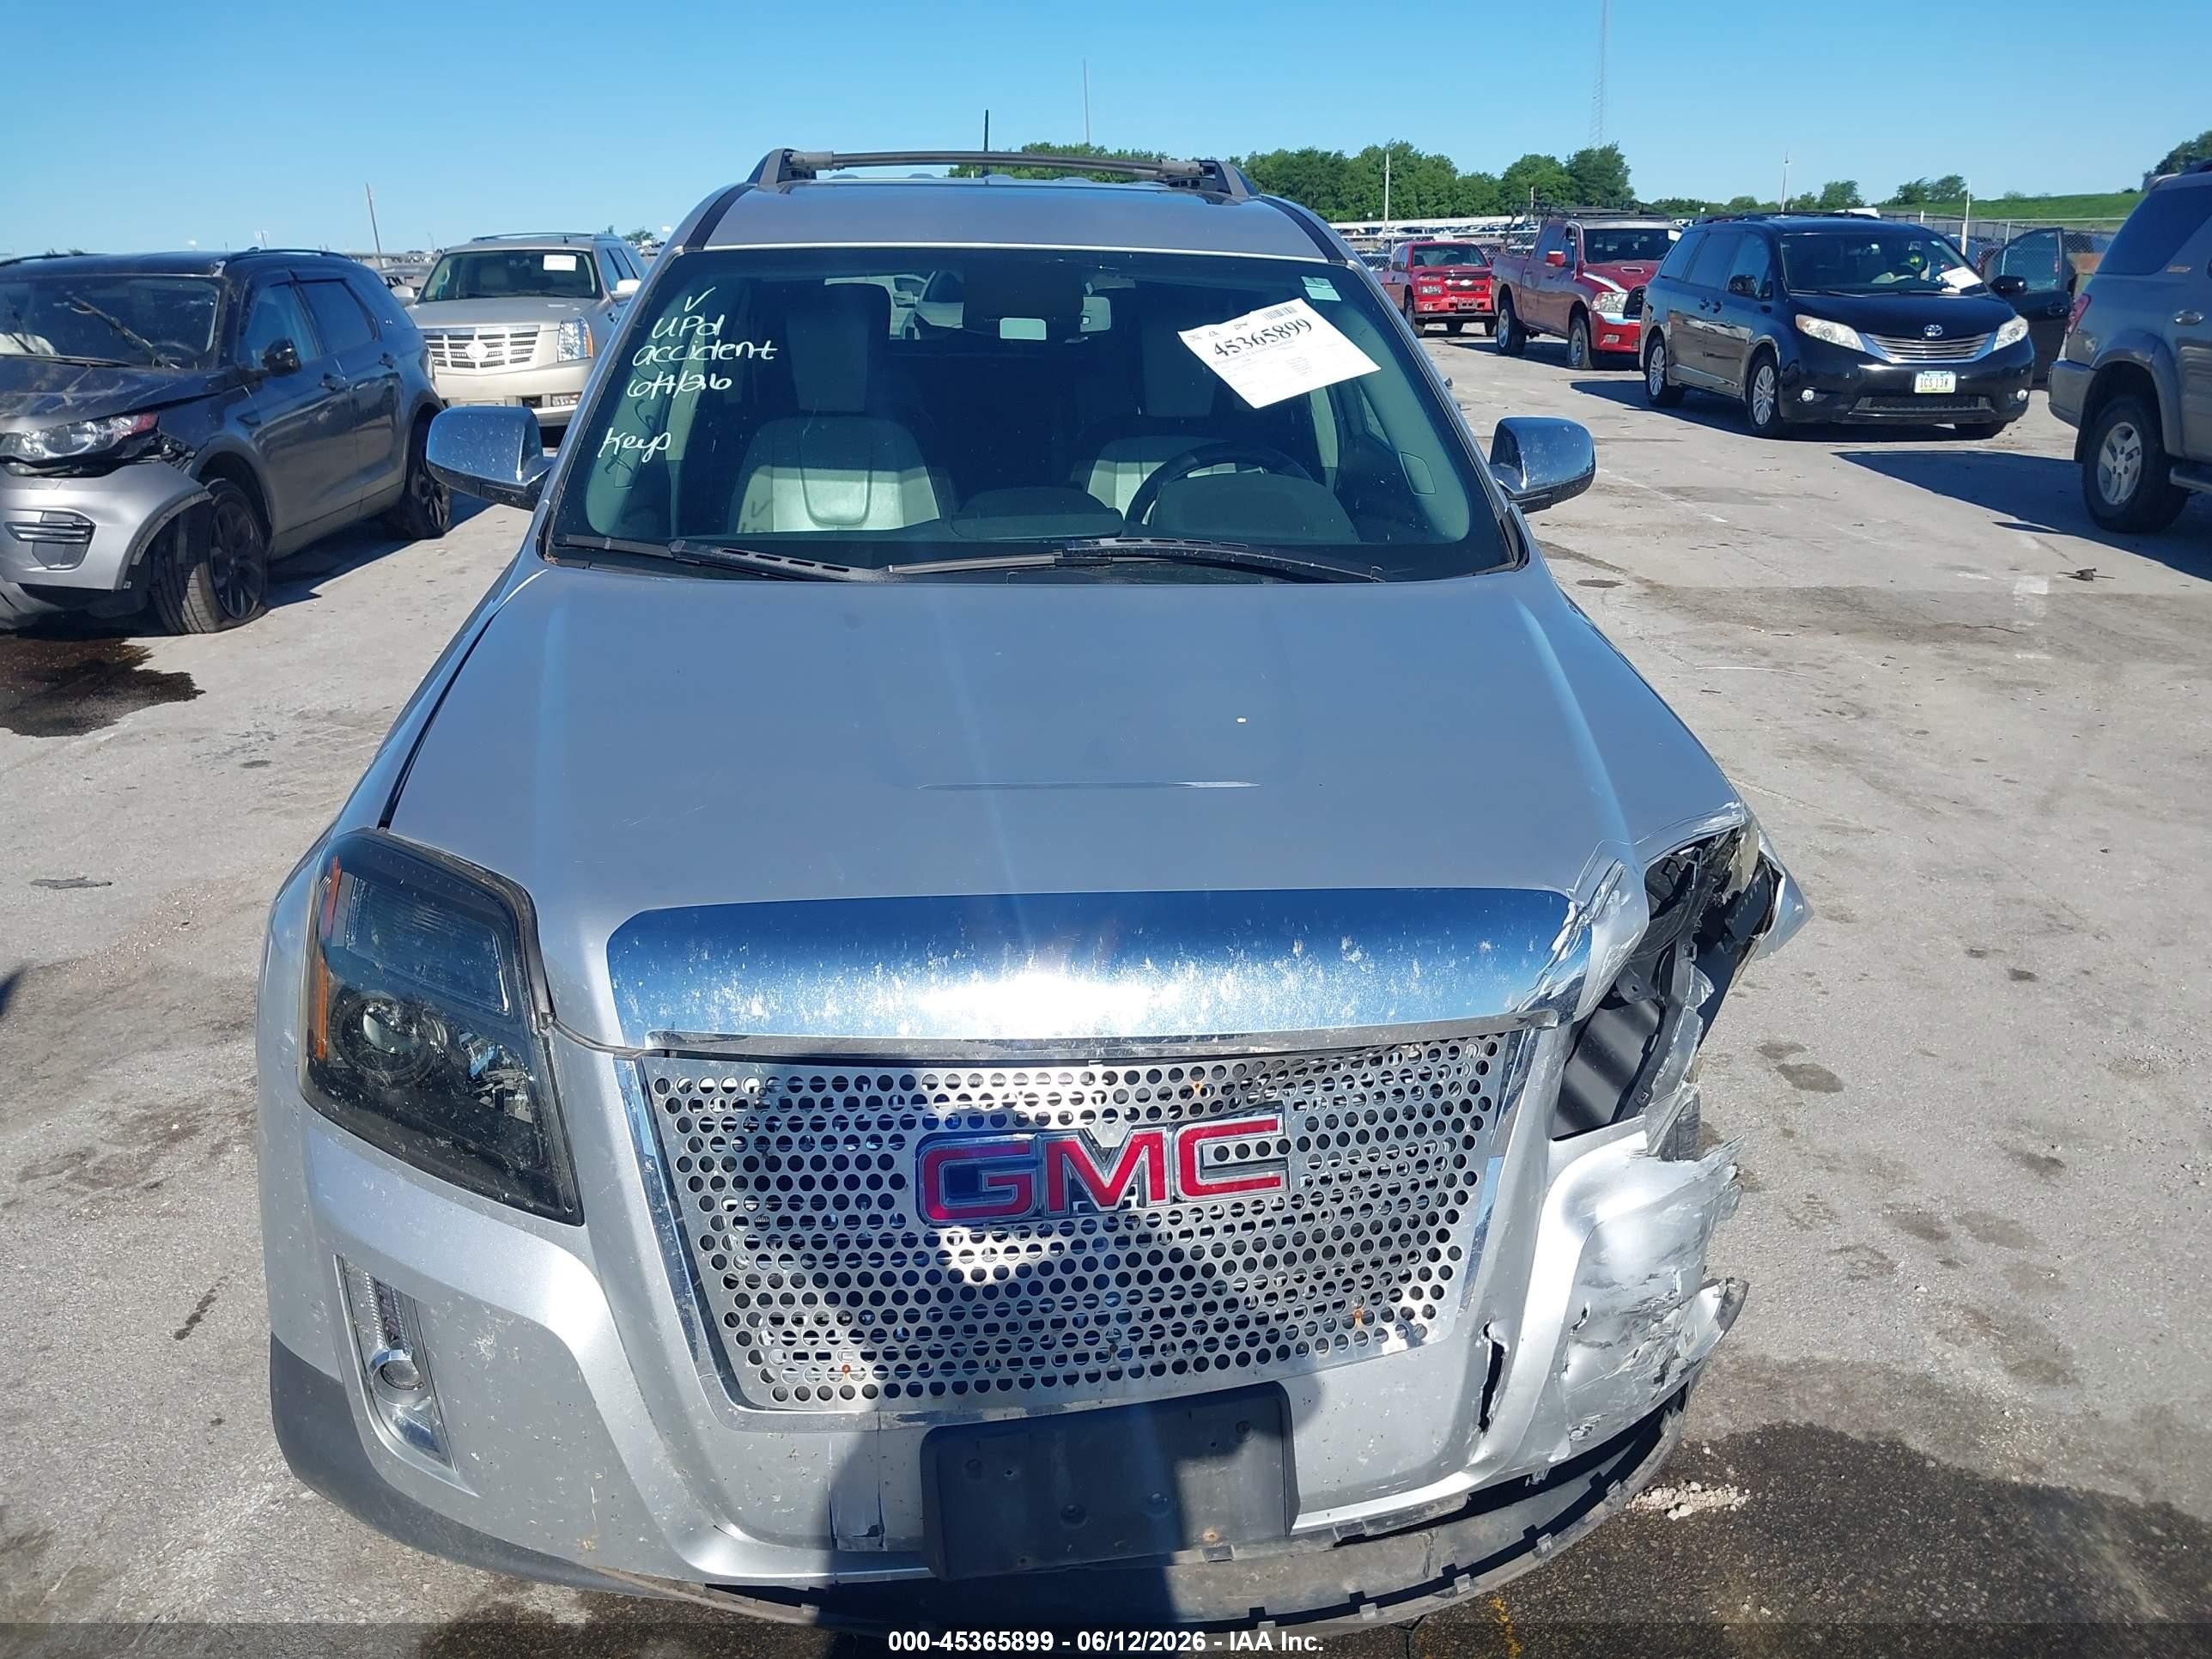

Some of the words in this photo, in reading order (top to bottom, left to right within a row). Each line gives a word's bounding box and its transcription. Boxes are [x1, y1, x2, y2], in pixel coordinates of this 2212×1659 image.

[632, 339, 778, 367] accident
[1213, 318, 1312, 356] 45365899
[916, 1104, 1288, 1224] GMC
